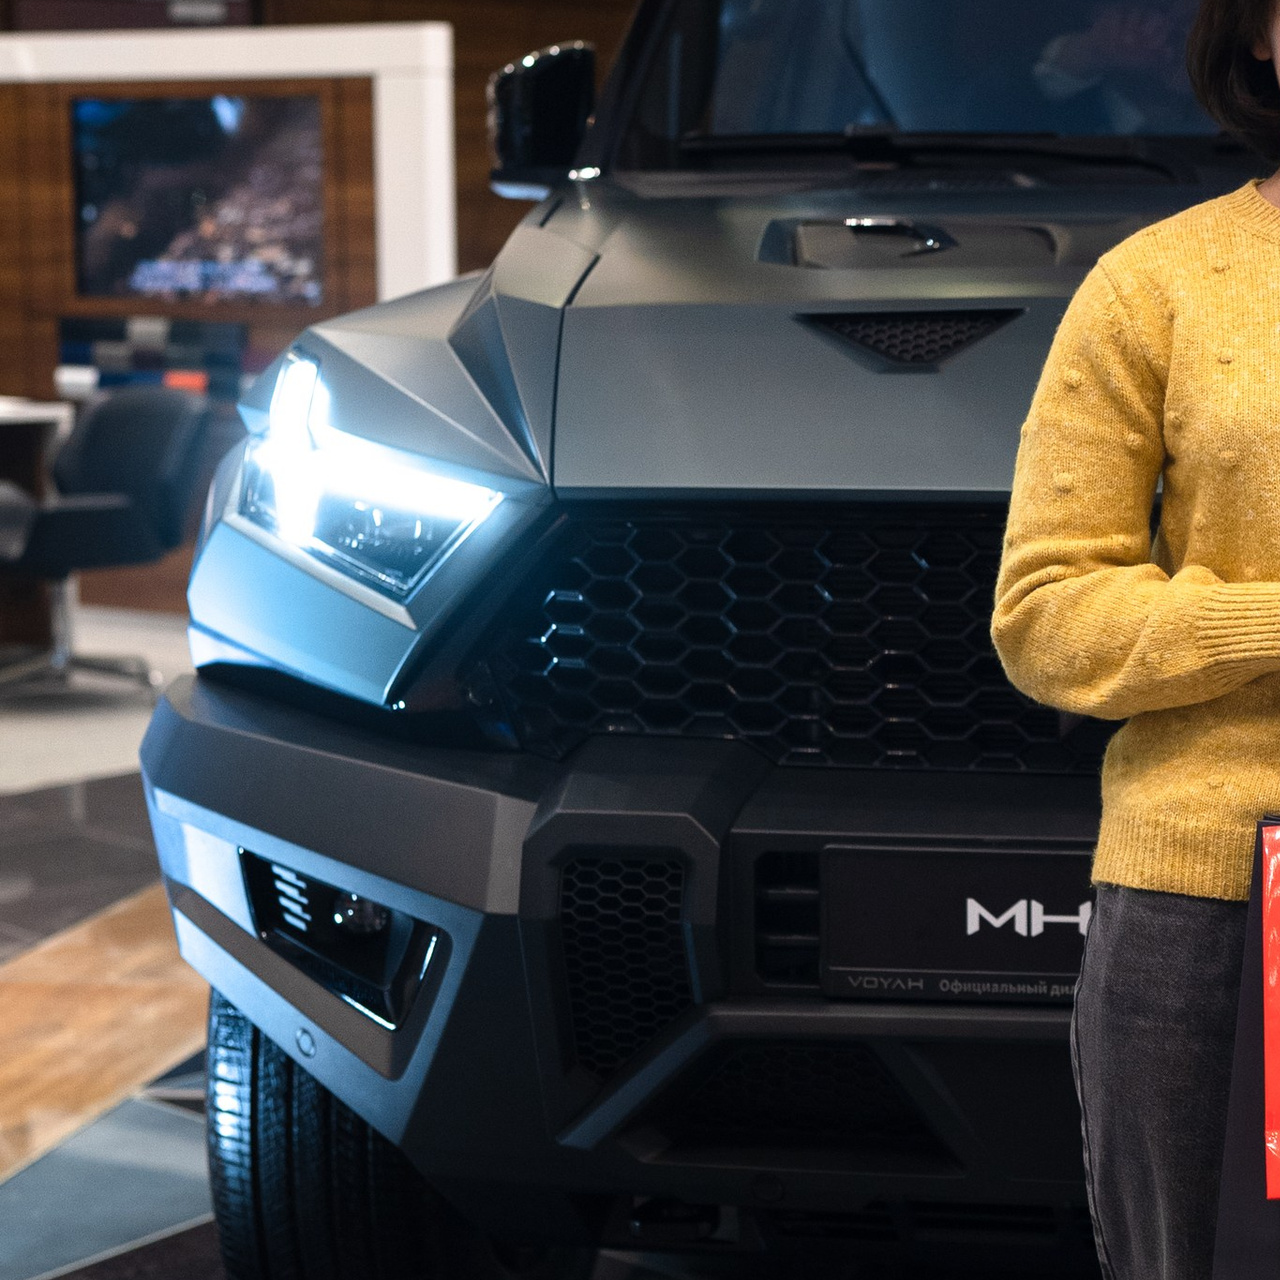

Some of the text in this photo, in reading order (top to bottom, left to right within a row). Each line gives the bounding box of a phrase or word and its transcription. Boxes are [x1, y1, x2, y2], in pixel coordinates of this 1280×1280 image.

[848, 976, 1075, 997] VOYAH Официальный дил
